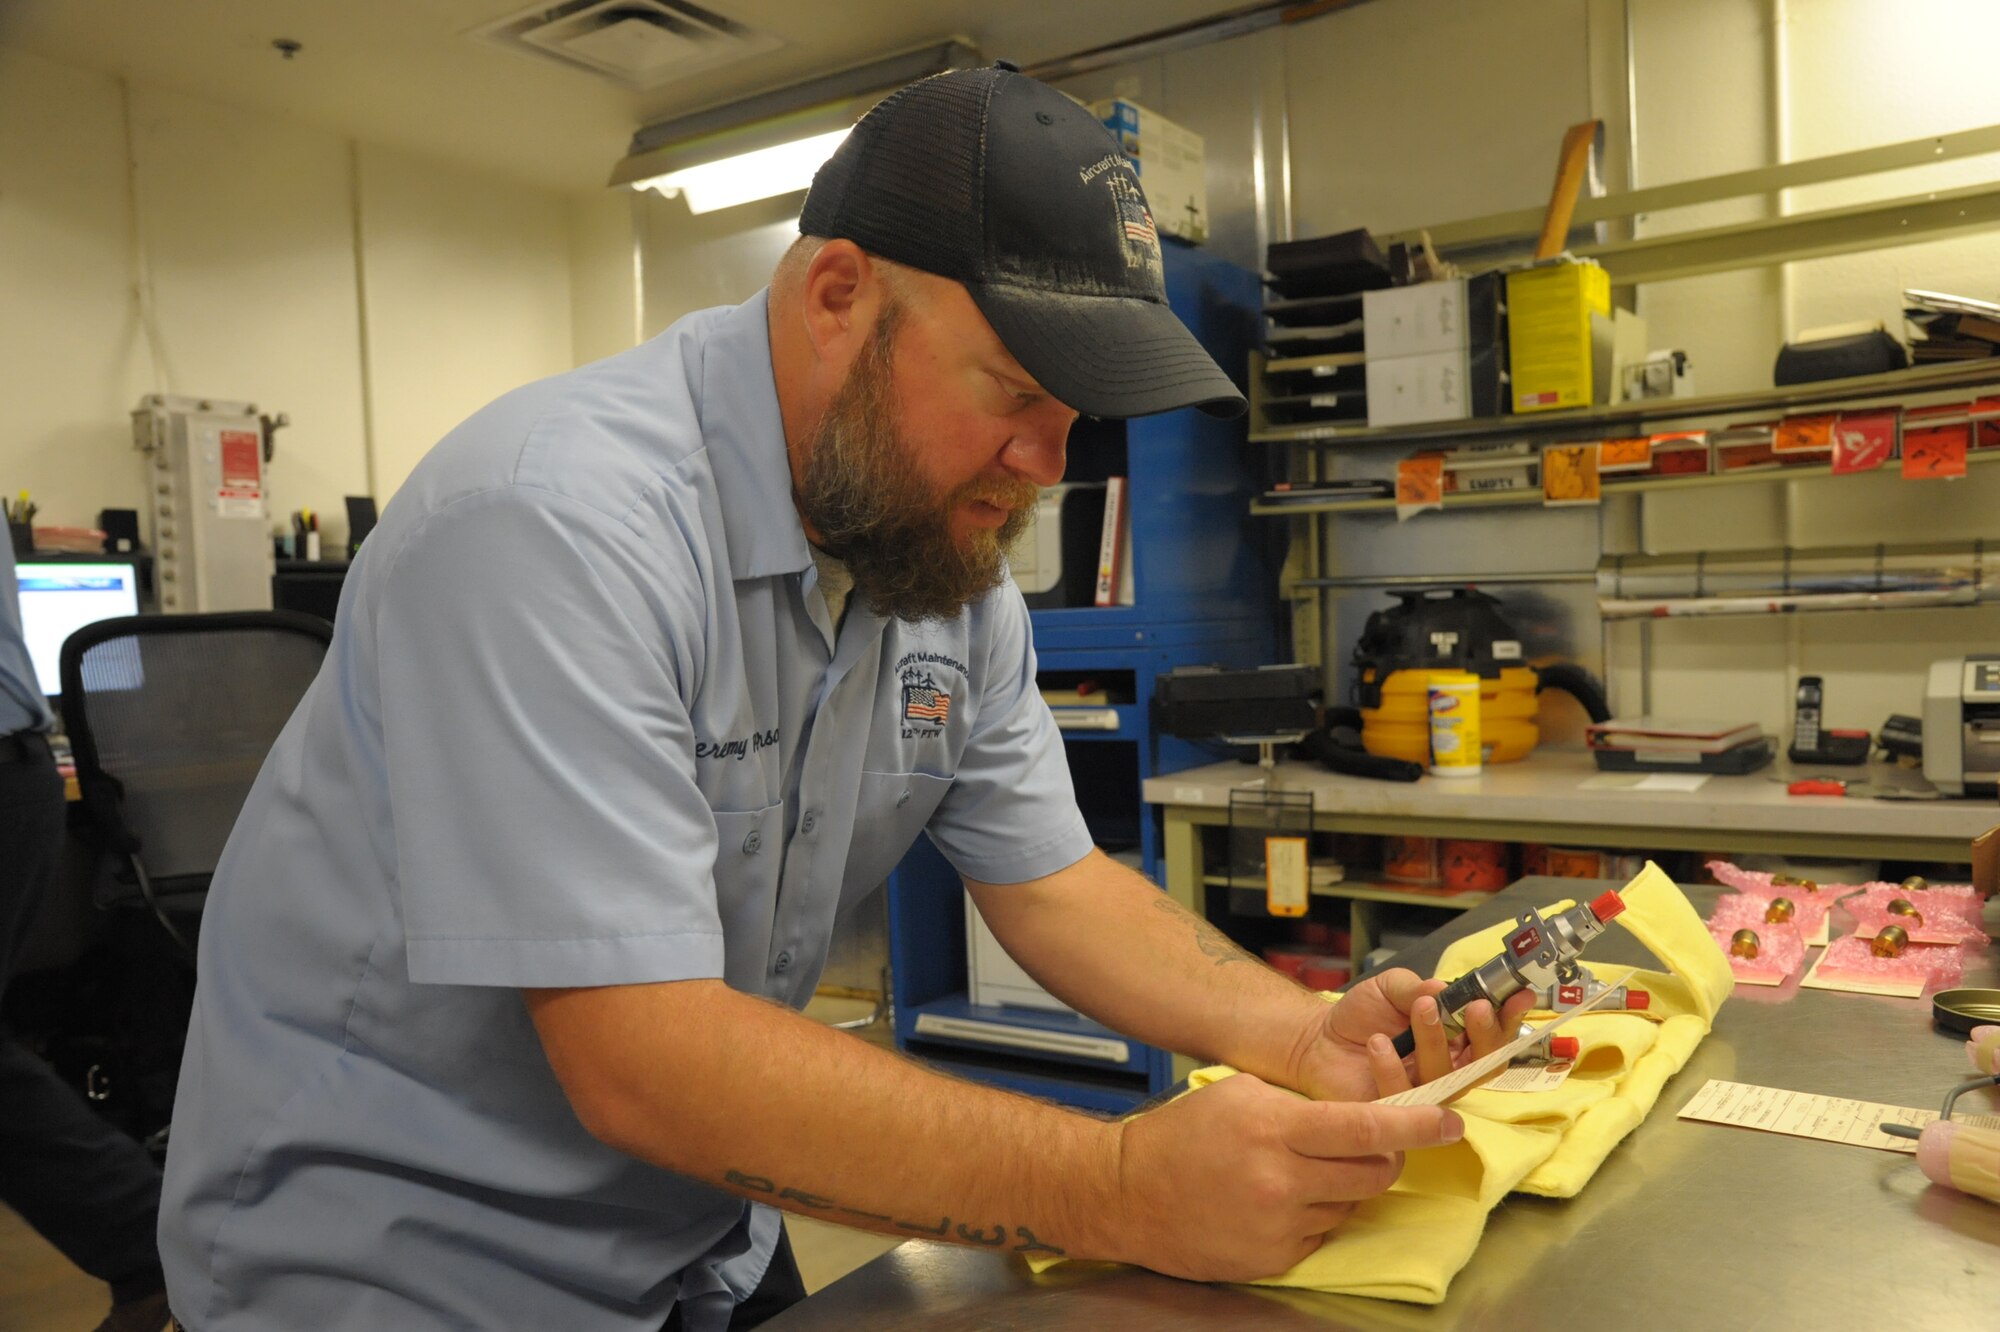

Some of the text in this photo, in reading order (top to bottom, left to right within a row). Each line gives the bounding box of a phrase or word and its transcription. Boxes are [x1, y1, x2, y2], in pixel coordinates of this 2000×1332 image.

[1079, 154, 1117, 185] Aircraft
[920, 727, 944, 739] FTW
[695, 737, 749, 761] eremy
